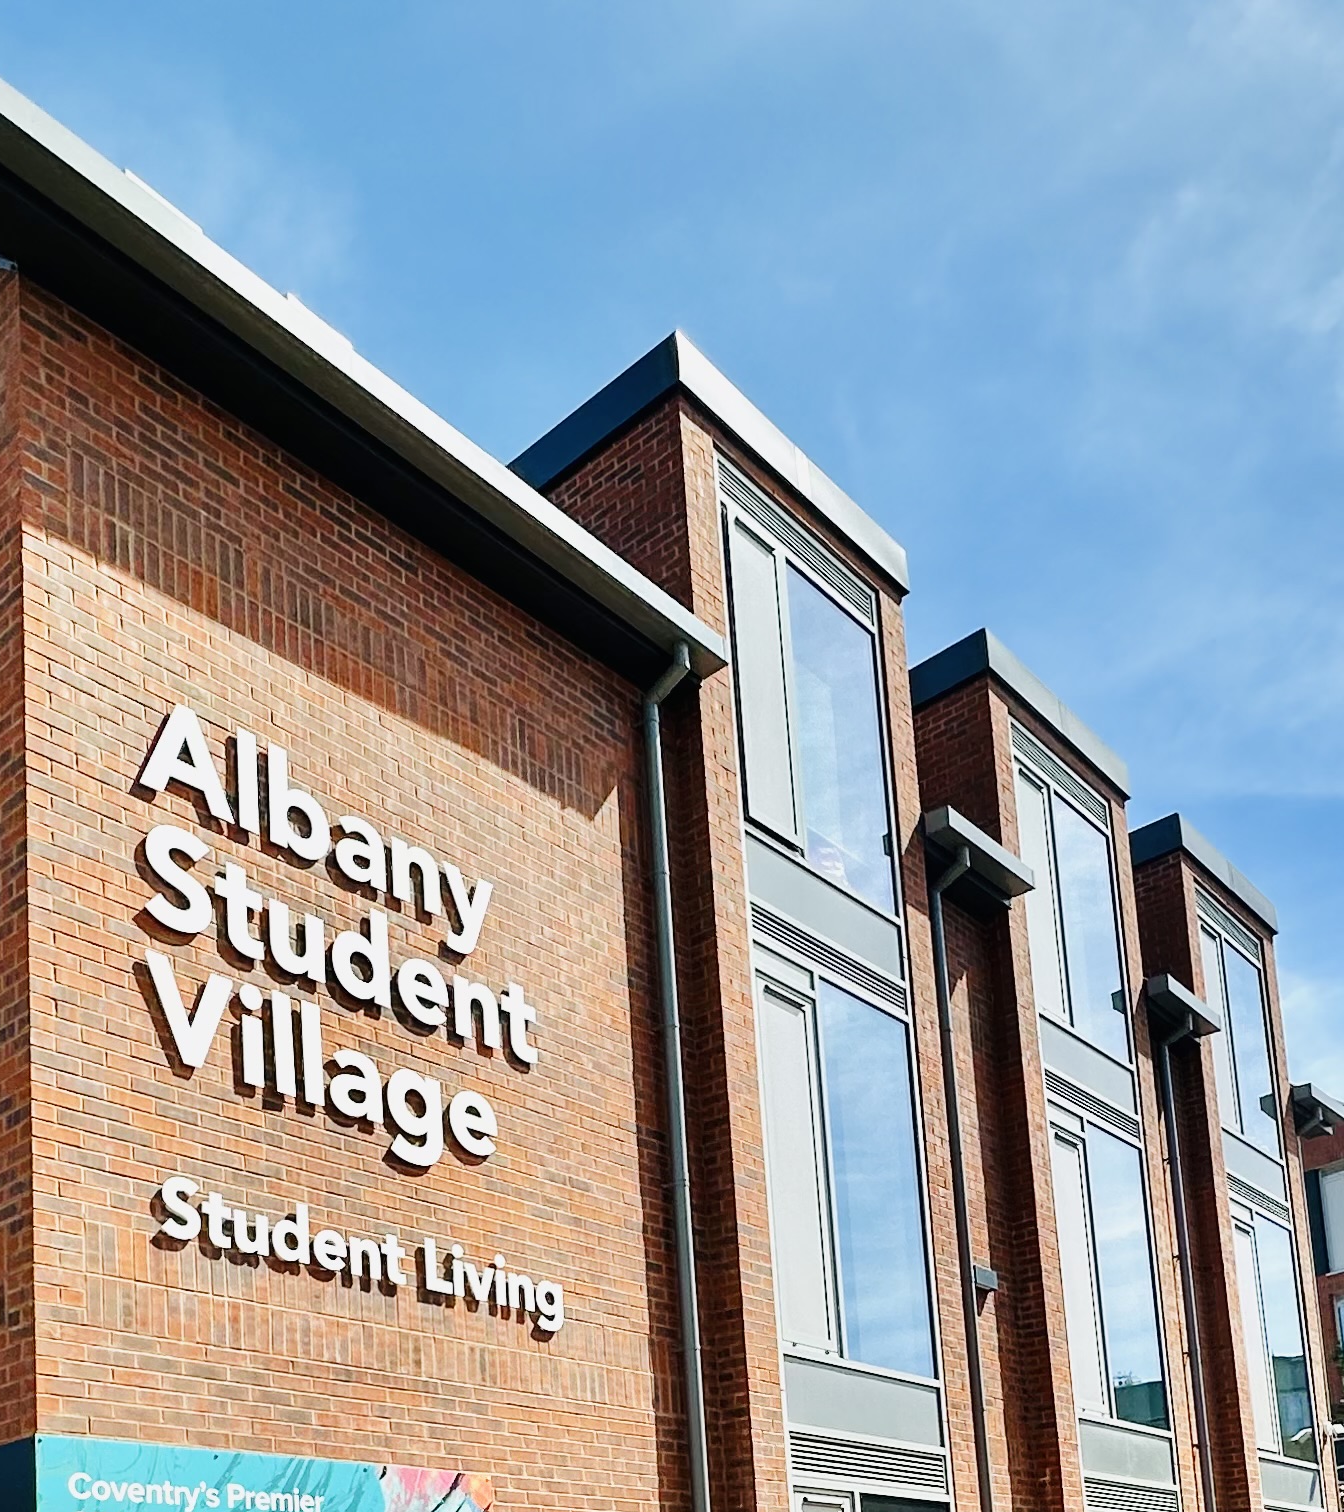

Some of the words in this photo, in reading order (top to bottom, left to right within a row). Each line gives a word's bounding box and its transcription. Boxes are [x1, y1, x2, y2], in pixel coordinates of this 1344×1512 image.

[140, 704, 494, 955] Albany
[145, 824, 539, 1065] Student
[145, 950, 498, 1167] Village
[160, 1176, 406, 1286] Student
[425, 1239, 565, 1333] Living
[67, 1472, 220, 1512] Coventry's
